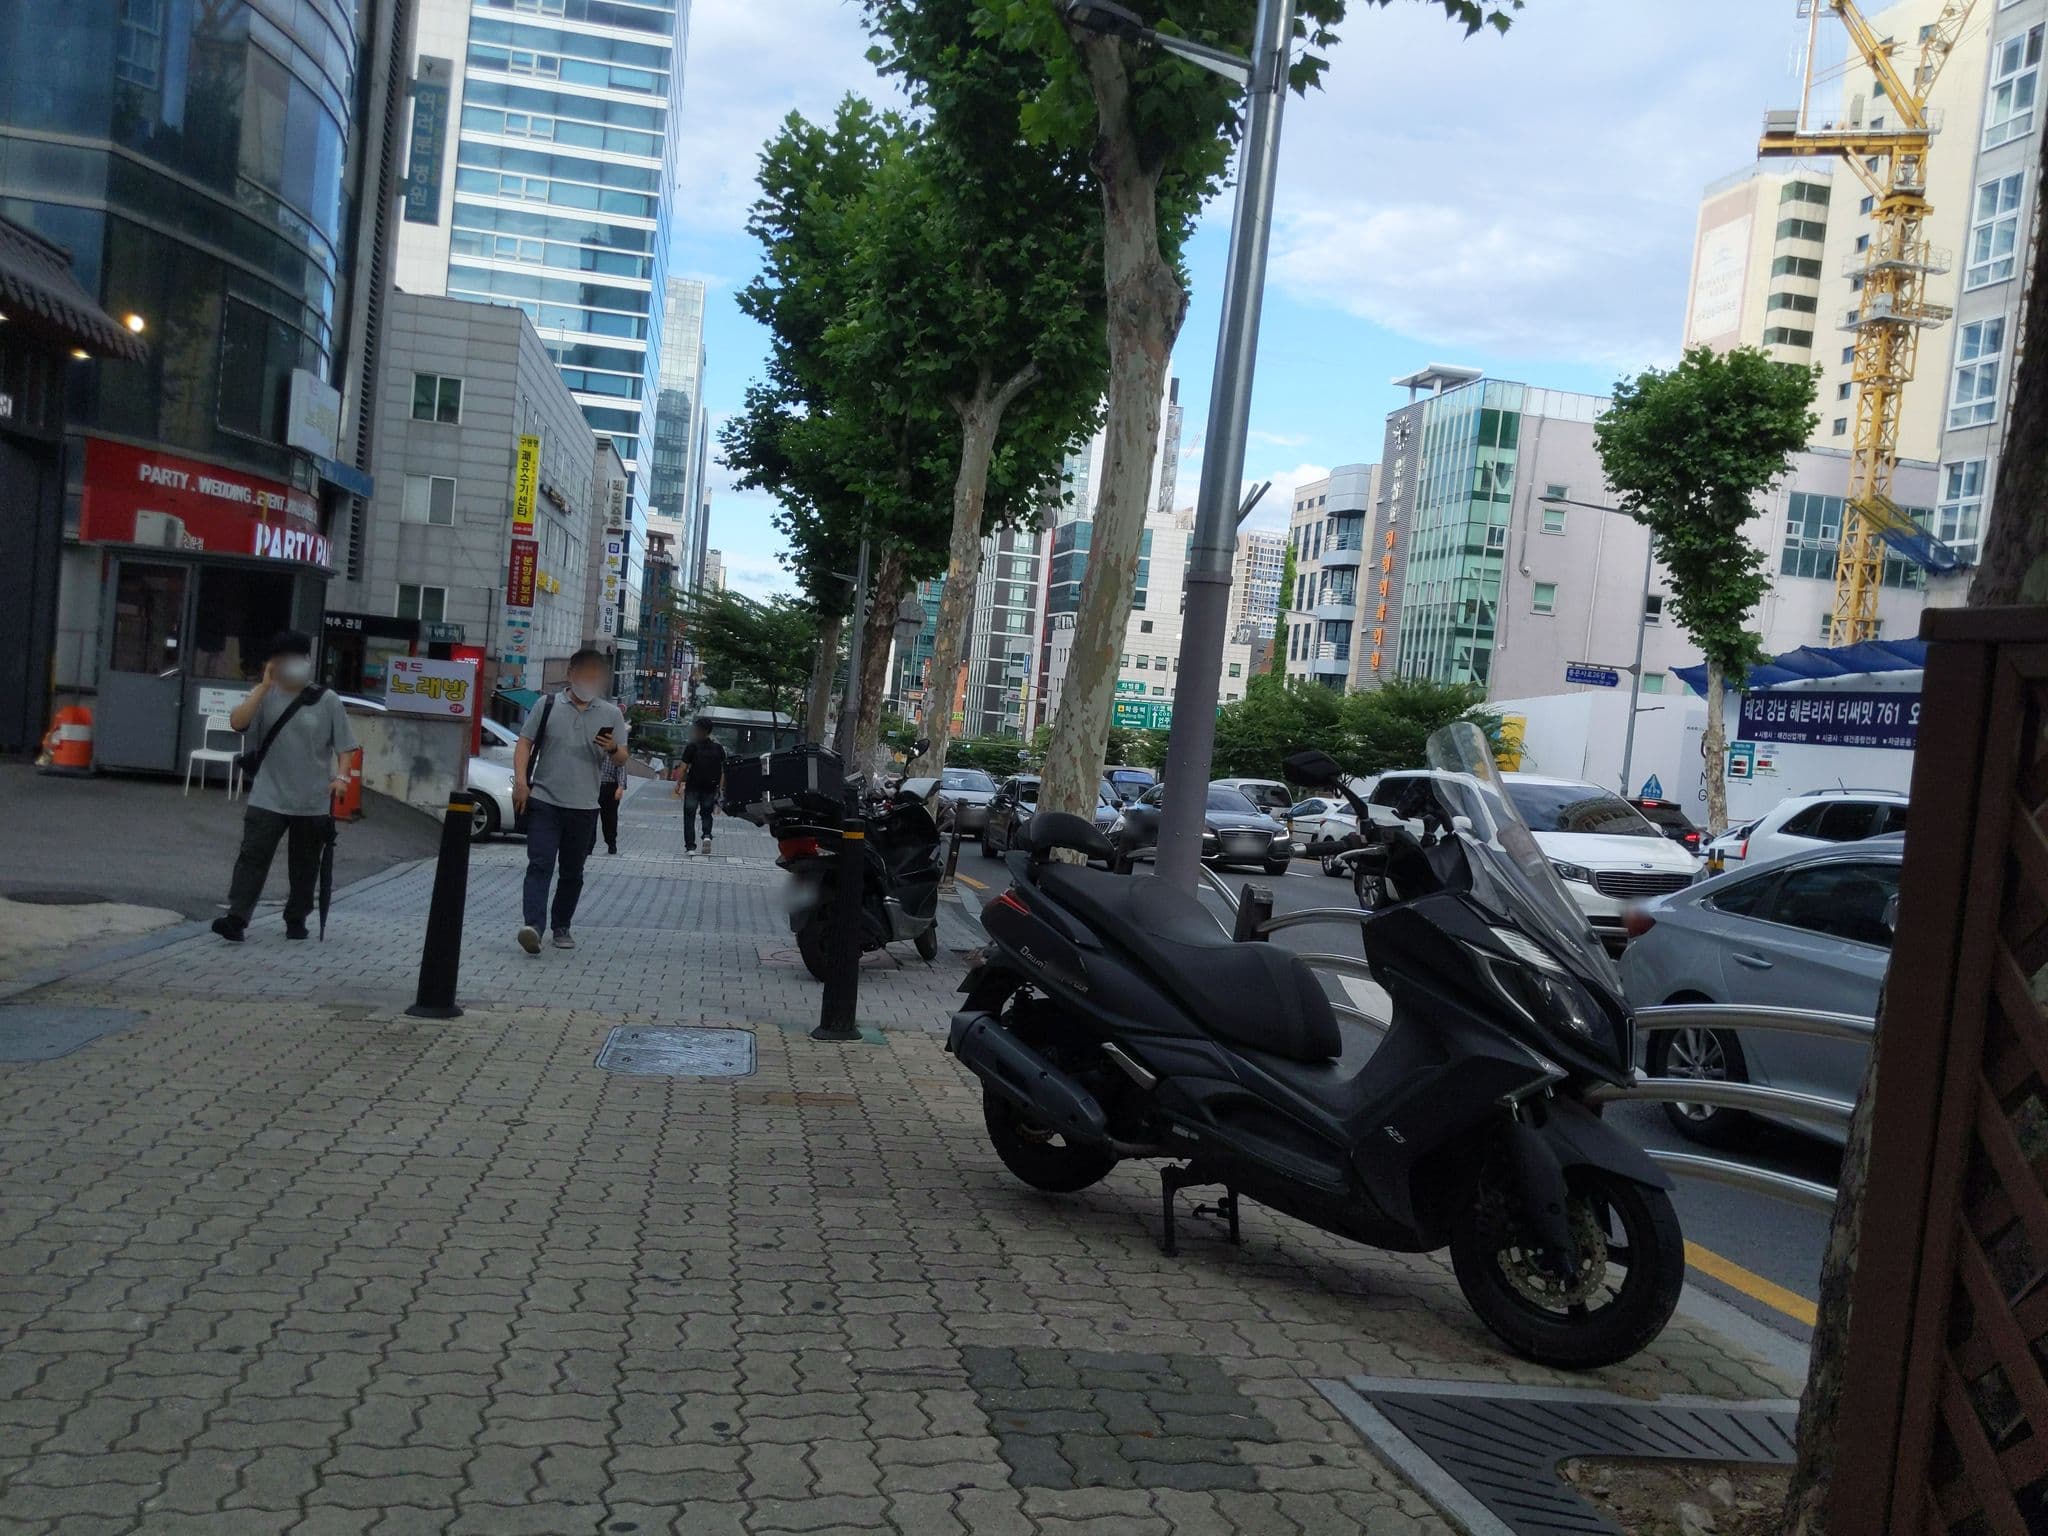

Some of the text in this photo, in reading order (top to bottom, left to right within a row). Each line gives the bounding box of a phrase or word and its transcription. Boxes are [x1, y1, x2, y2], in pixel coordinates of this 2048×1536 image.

[139, 463, 189, 490] PARTY
[198, 475, 251, 503] WEDDING
[254, 522, 315, 563] PARTY
[394, 660, 423, 673] 레드
[391, 674, 469, 701] 노래방
[1744, 699, 1765, 721] 태건
[1767, 699, 1787, 722] 강남
[1789, 699, 1834, 724] 헤븐리치
[1837, 700, 1874, 725] 더써밋
[1877, 702, 1900, 725] 761
